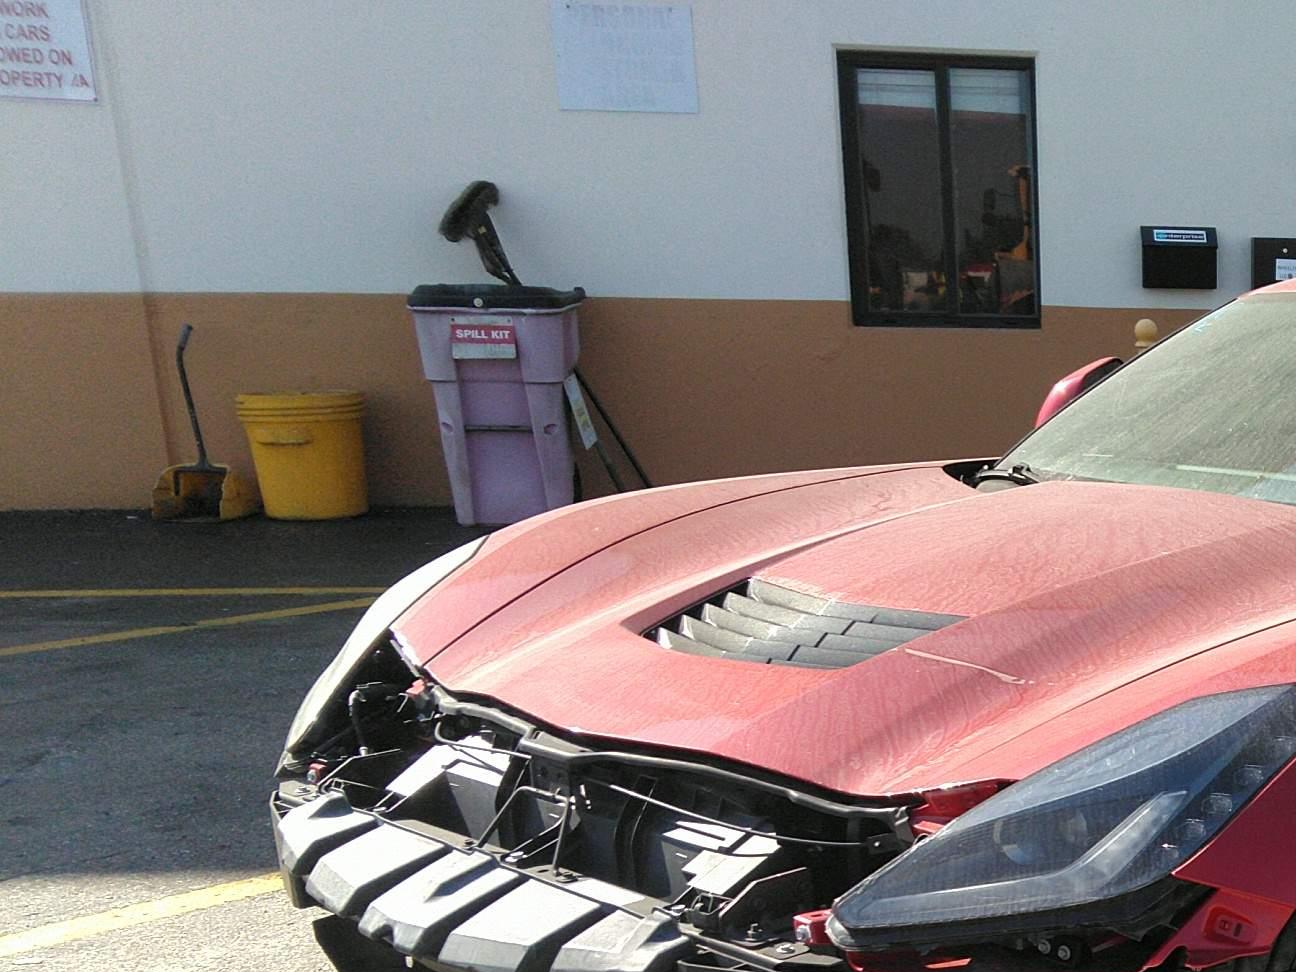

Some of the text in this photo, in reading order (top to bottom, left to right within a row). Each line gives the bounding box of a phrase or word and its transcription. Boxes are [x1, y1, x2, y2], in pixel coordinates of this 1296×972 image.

[5, 23, 49, 41] CARS
[48, 48, 72, 65] ON
[455, 328, 511, 339] SPILL KIT
